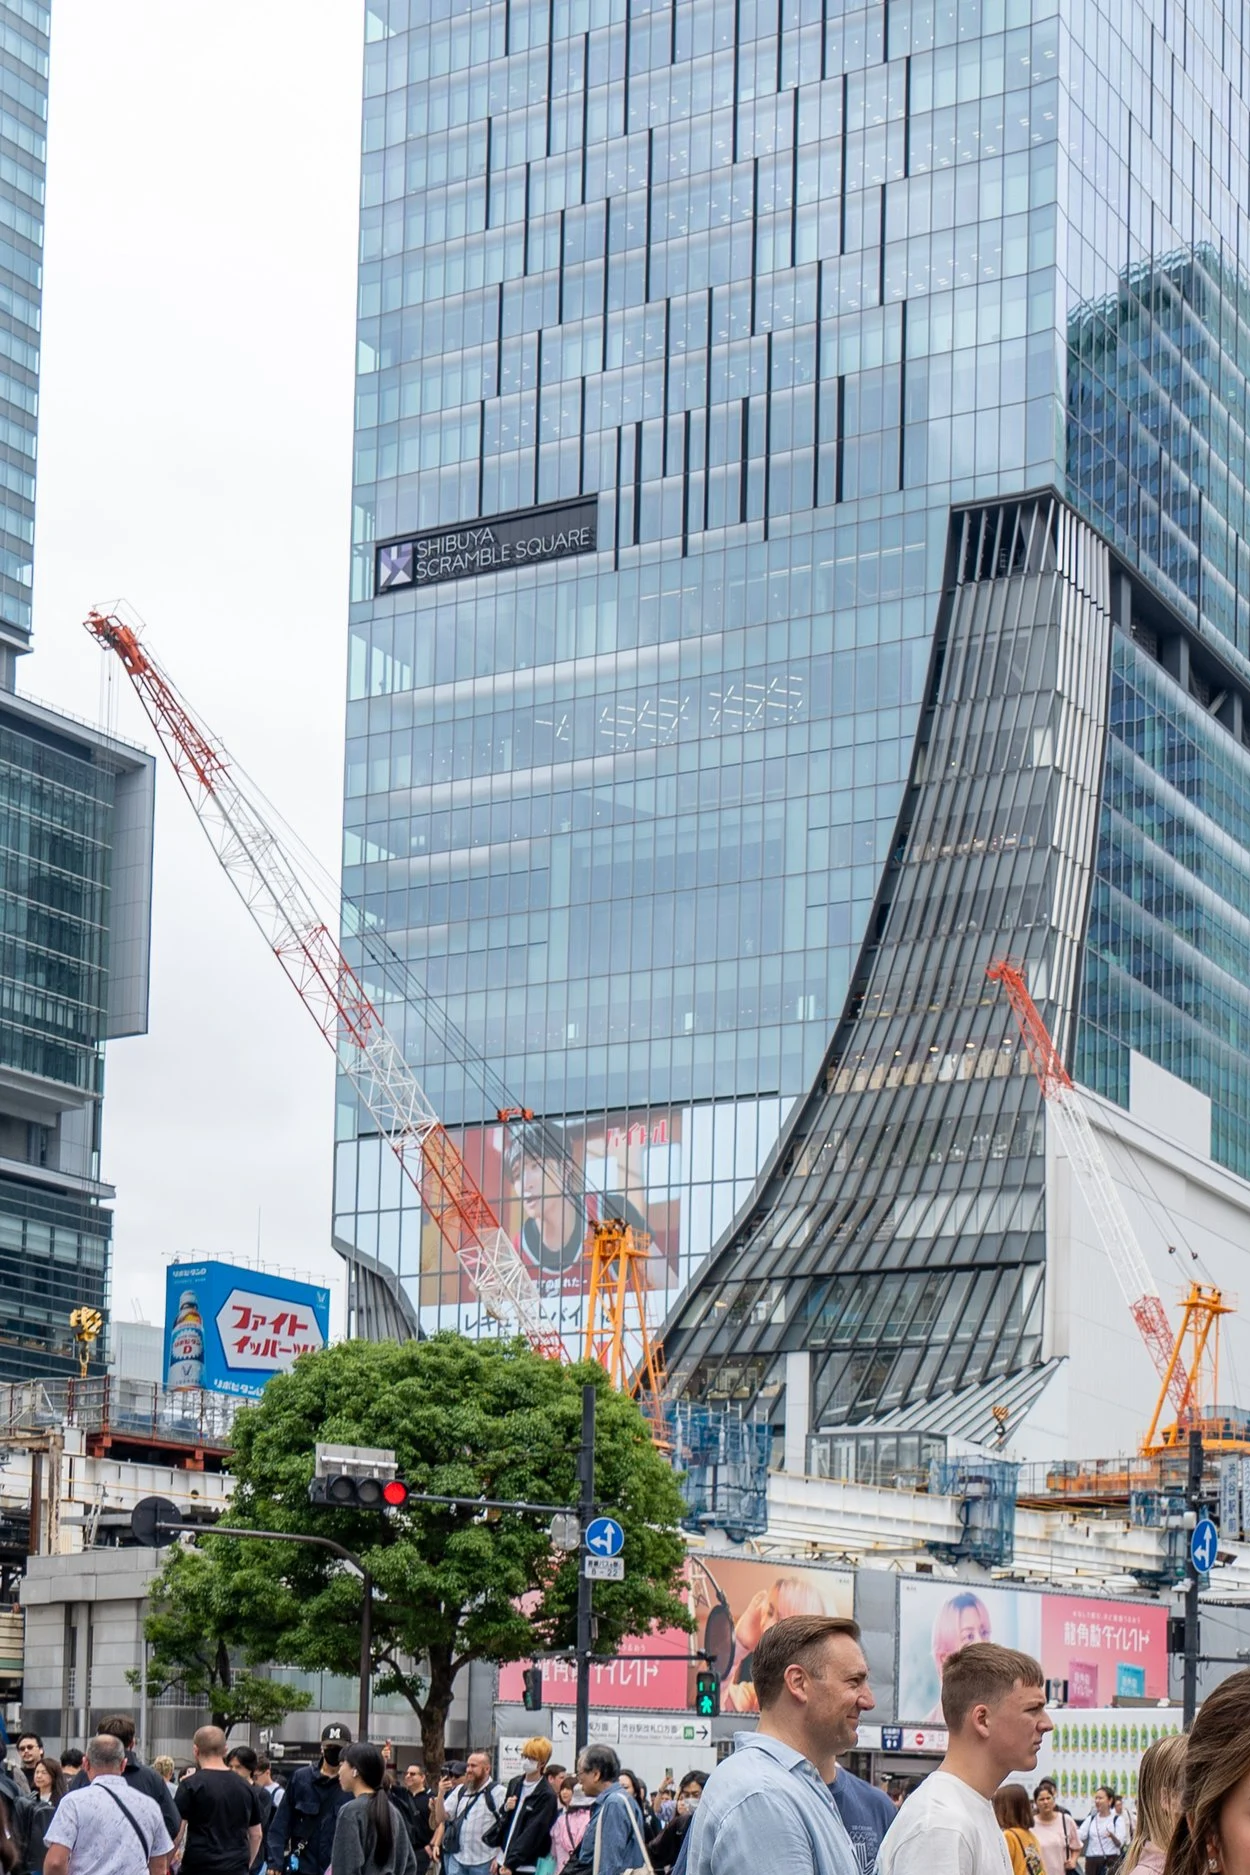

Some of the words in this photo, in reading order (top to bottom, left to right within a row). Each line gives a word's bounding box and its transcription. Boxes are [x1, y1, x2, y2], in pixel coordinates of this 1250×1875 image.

[416, 527, 494, 559] SHIBUYA
[416, 543, 510, 579] SCRAMBLE
[515, 527, 590, 559] SQUARE
[232, 1305, 308, 1337] ファイト
[183, 1345, 193, 1354] D
[329, 1728, 341, 1739] M
